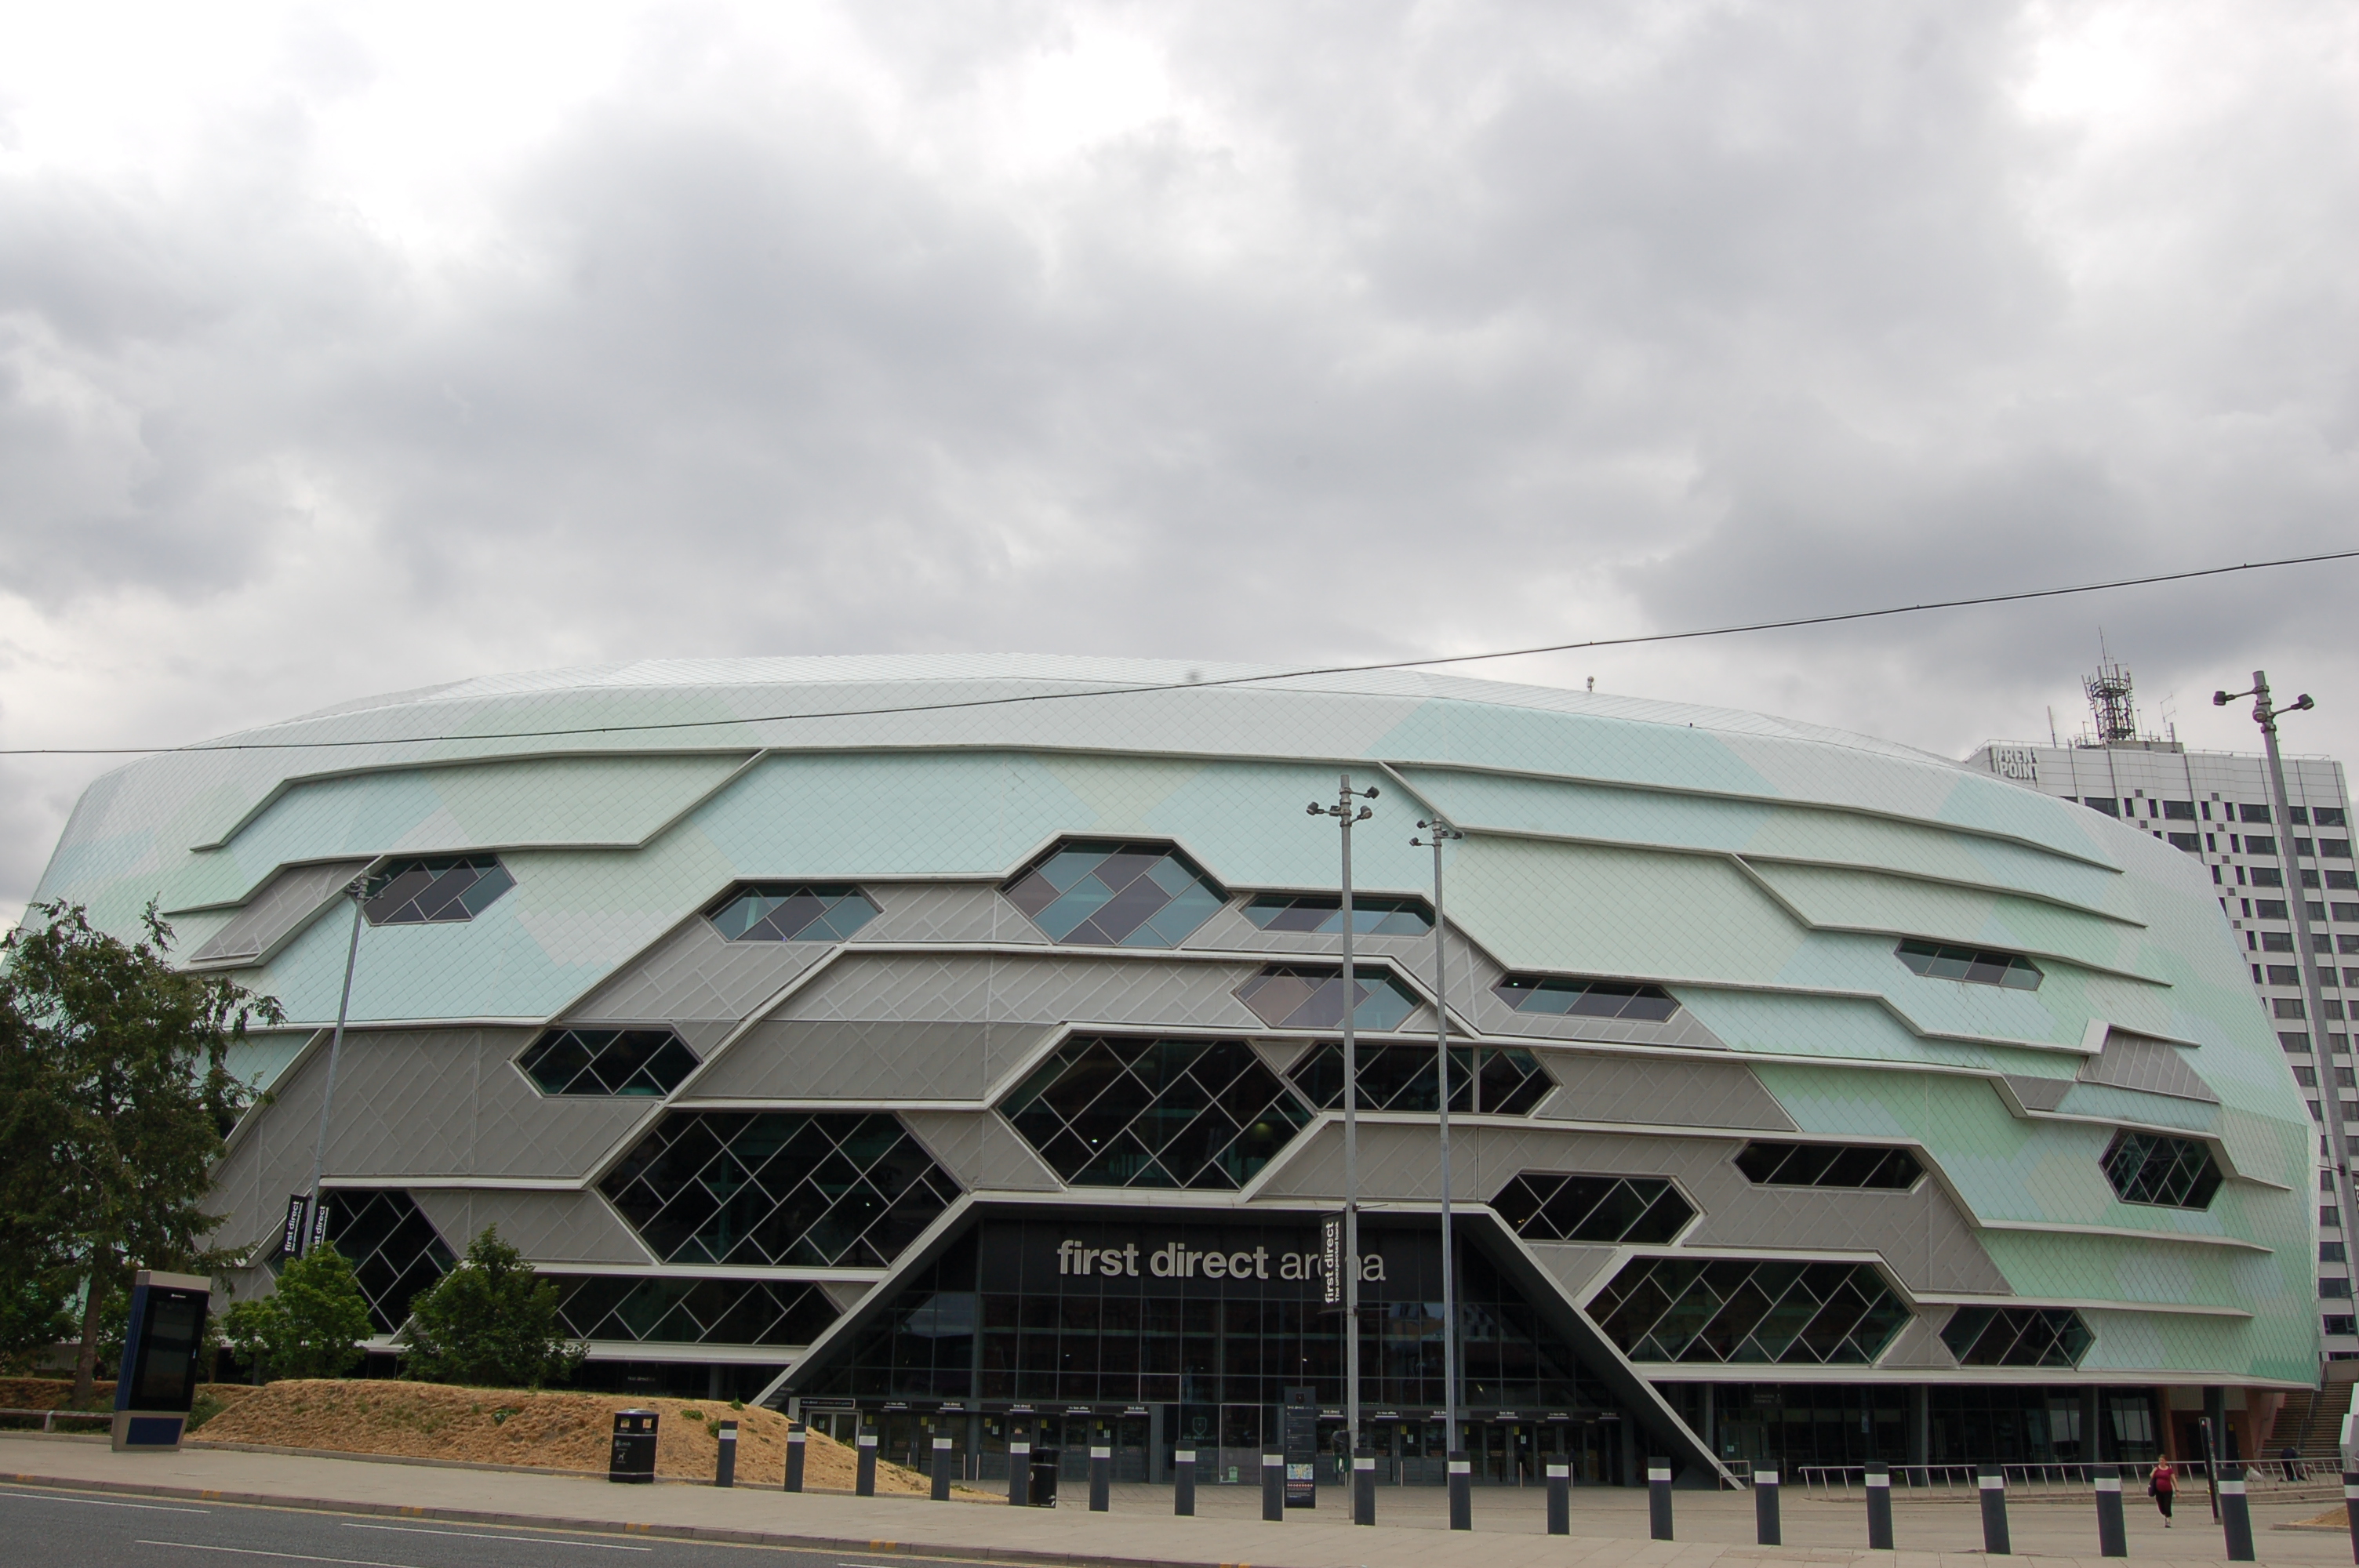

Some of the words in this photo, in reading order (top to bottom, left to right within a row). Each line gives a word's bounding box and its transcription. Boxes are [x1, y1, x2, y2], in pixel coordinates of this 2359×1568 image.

[1998, 761, 2039, 779] POINT
[288, 1200, 300, 1229] direct
[315, 1206, 326, 1234] direct
[285, 1232, 293, 1251] first
[1325, 1221, 1333, 1268] direct
[1057, 1240, 1139, 1276] first
[1150, 1242, 1269, 1279] direct
[1280, 1252, 1386, 1281] ara
[1325, 1270, 1334, 1304] first
